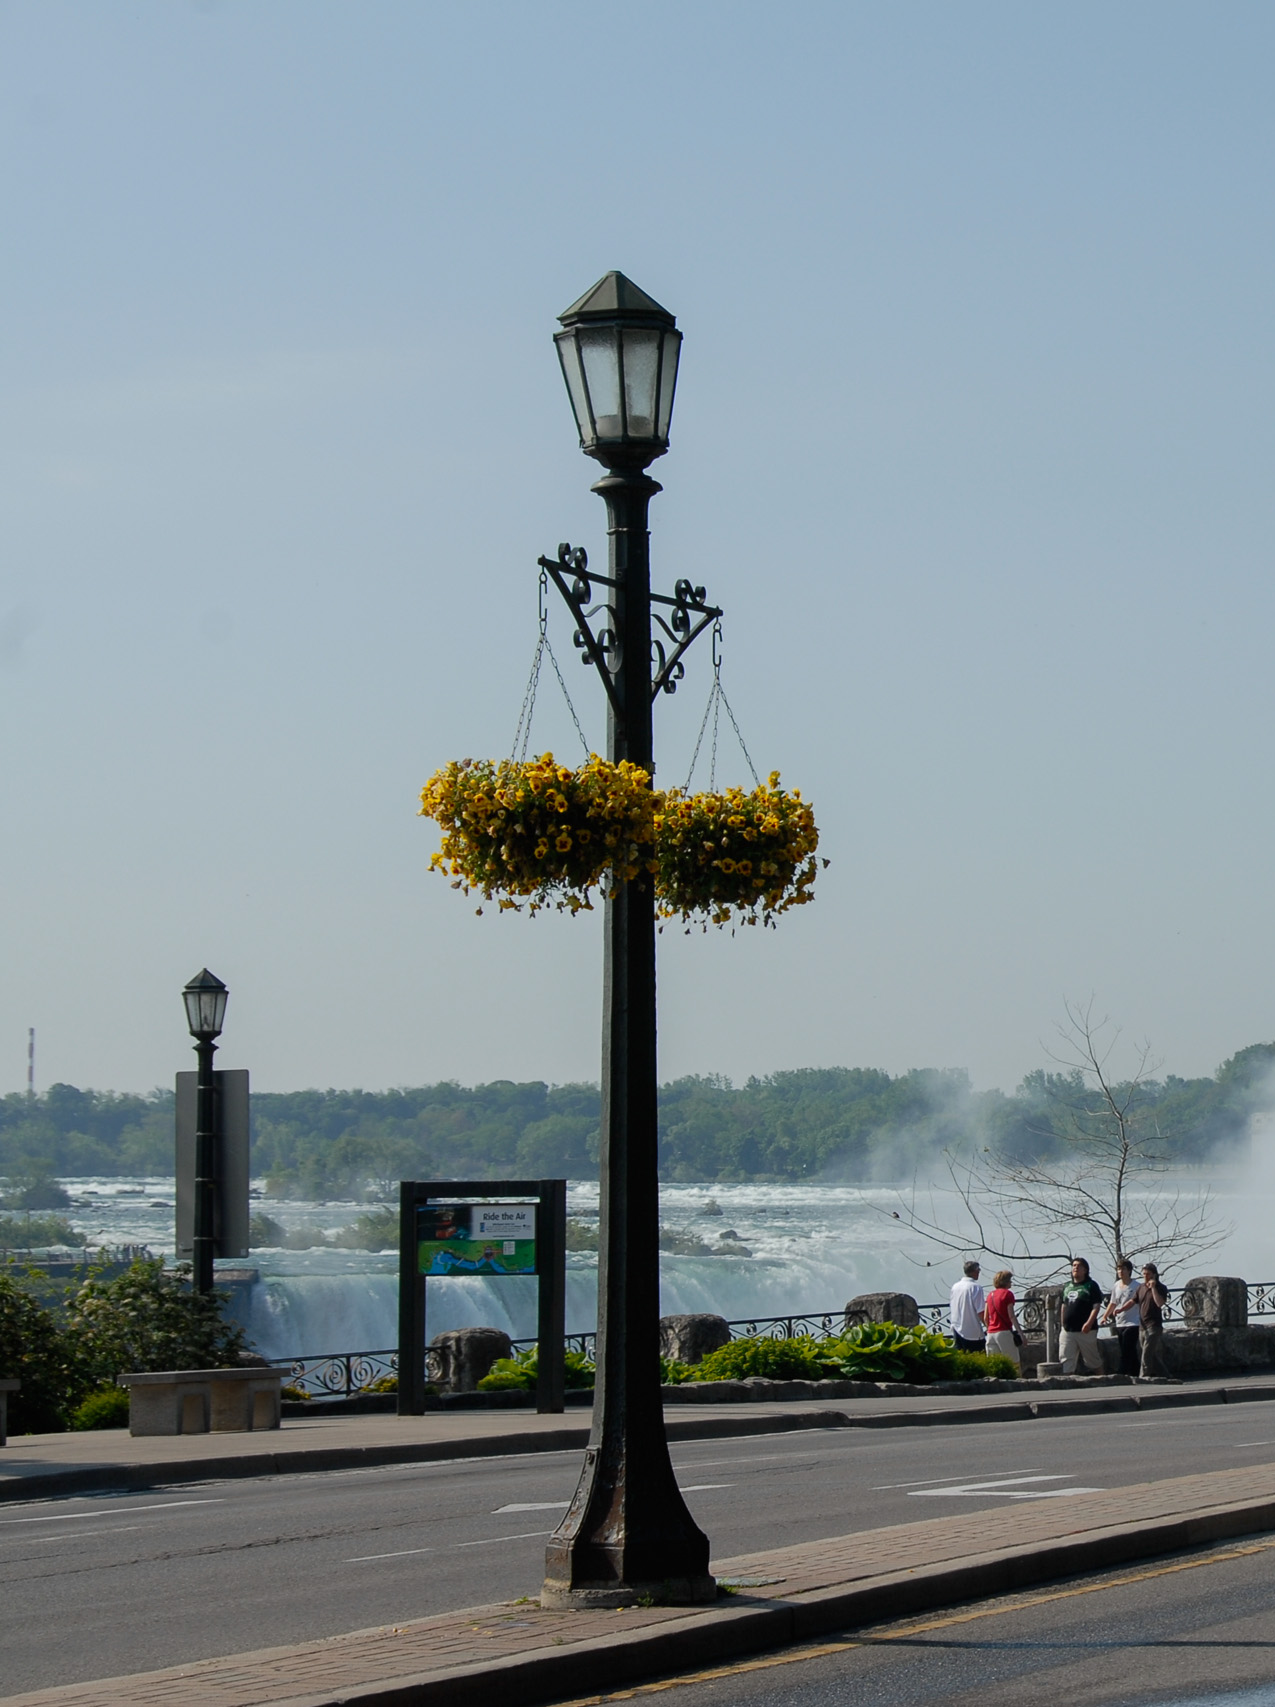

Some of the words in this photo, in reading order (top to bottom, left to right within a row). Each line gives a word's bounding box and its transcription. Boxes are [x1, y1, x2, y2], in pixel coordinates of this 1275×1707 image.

[483, 1212, 500, 1220] Ride
[501, 1212, 514, 1220] the
[515, 1212, 526, 1220] Air
